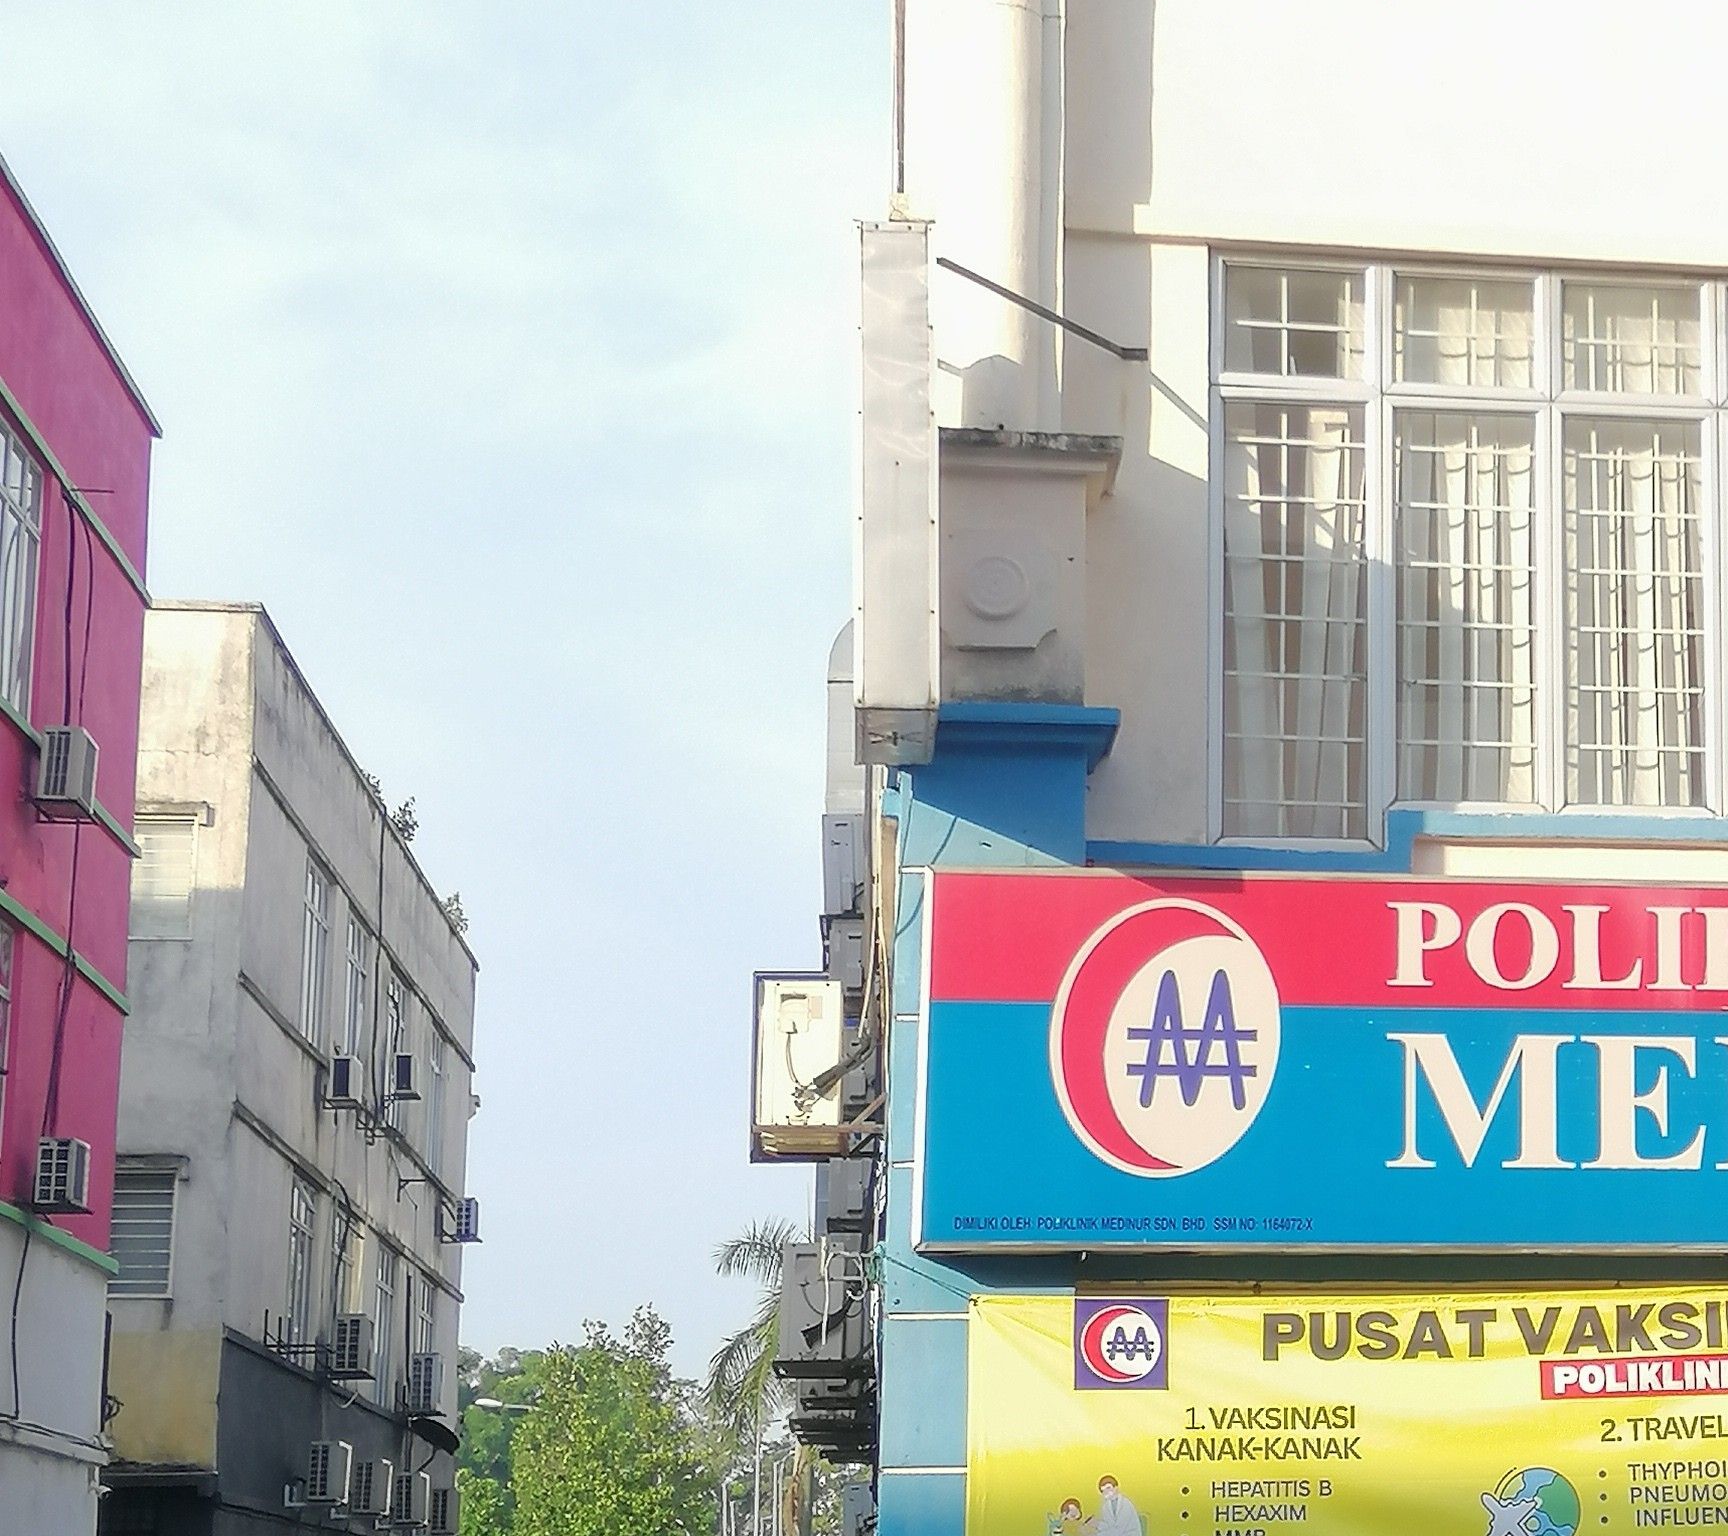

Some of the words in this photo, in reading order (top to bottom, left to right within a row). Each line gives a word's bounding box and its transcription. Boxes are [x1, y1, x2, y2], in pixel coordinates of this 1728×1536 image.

[1037, 1216, 1099, 1232] POLIKLINIK
[1101, 1216, 1150, 1232] MEDINUR
[1261, 1308, 1497, 1362] PUSAT
[1207, 1405, 1357, 1432] VAKSINASI
[1156, 1436, 1363, 1463] KANAK-KANAK
[1210, 1480, 1311, 1500] HEPATITIS
[1319, 1479, 1333, 1498] B
[1214, 1505, 1307, 1524] HEXAXIM
